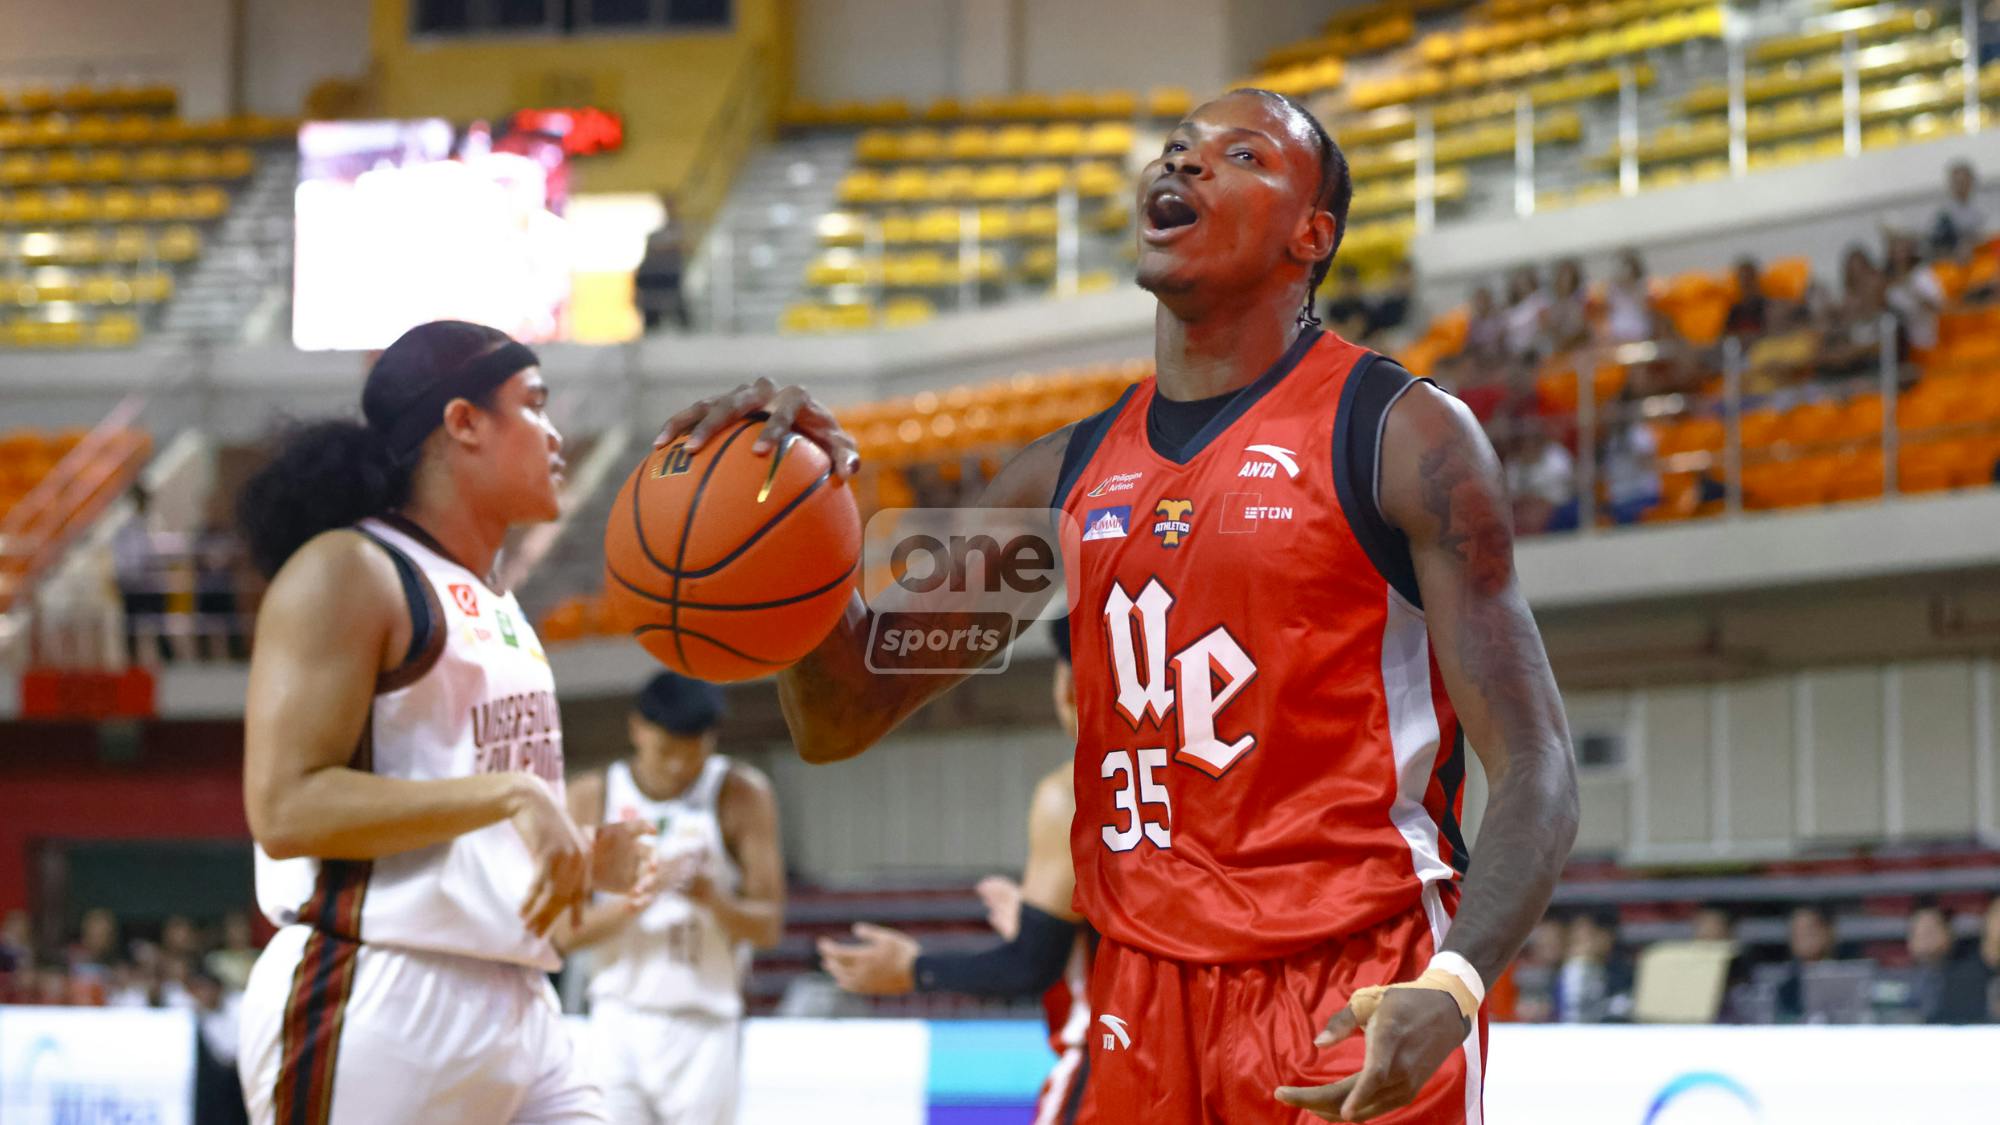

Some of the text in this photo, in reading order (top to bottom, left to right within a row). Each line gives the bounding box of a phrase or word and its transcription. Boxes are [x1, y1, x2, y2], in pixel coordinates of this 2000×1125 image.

[1237, 461, 1277, 479] ANTA
[1112, 472, 1143, 482] Philippine
[1109, 482, 1135, 492] Airlines
[1244, 506, 1294, 520] ETON
[1154, 521, 1190, 534] ATHLETICS
[1101, 748, 1172, 852] 35
